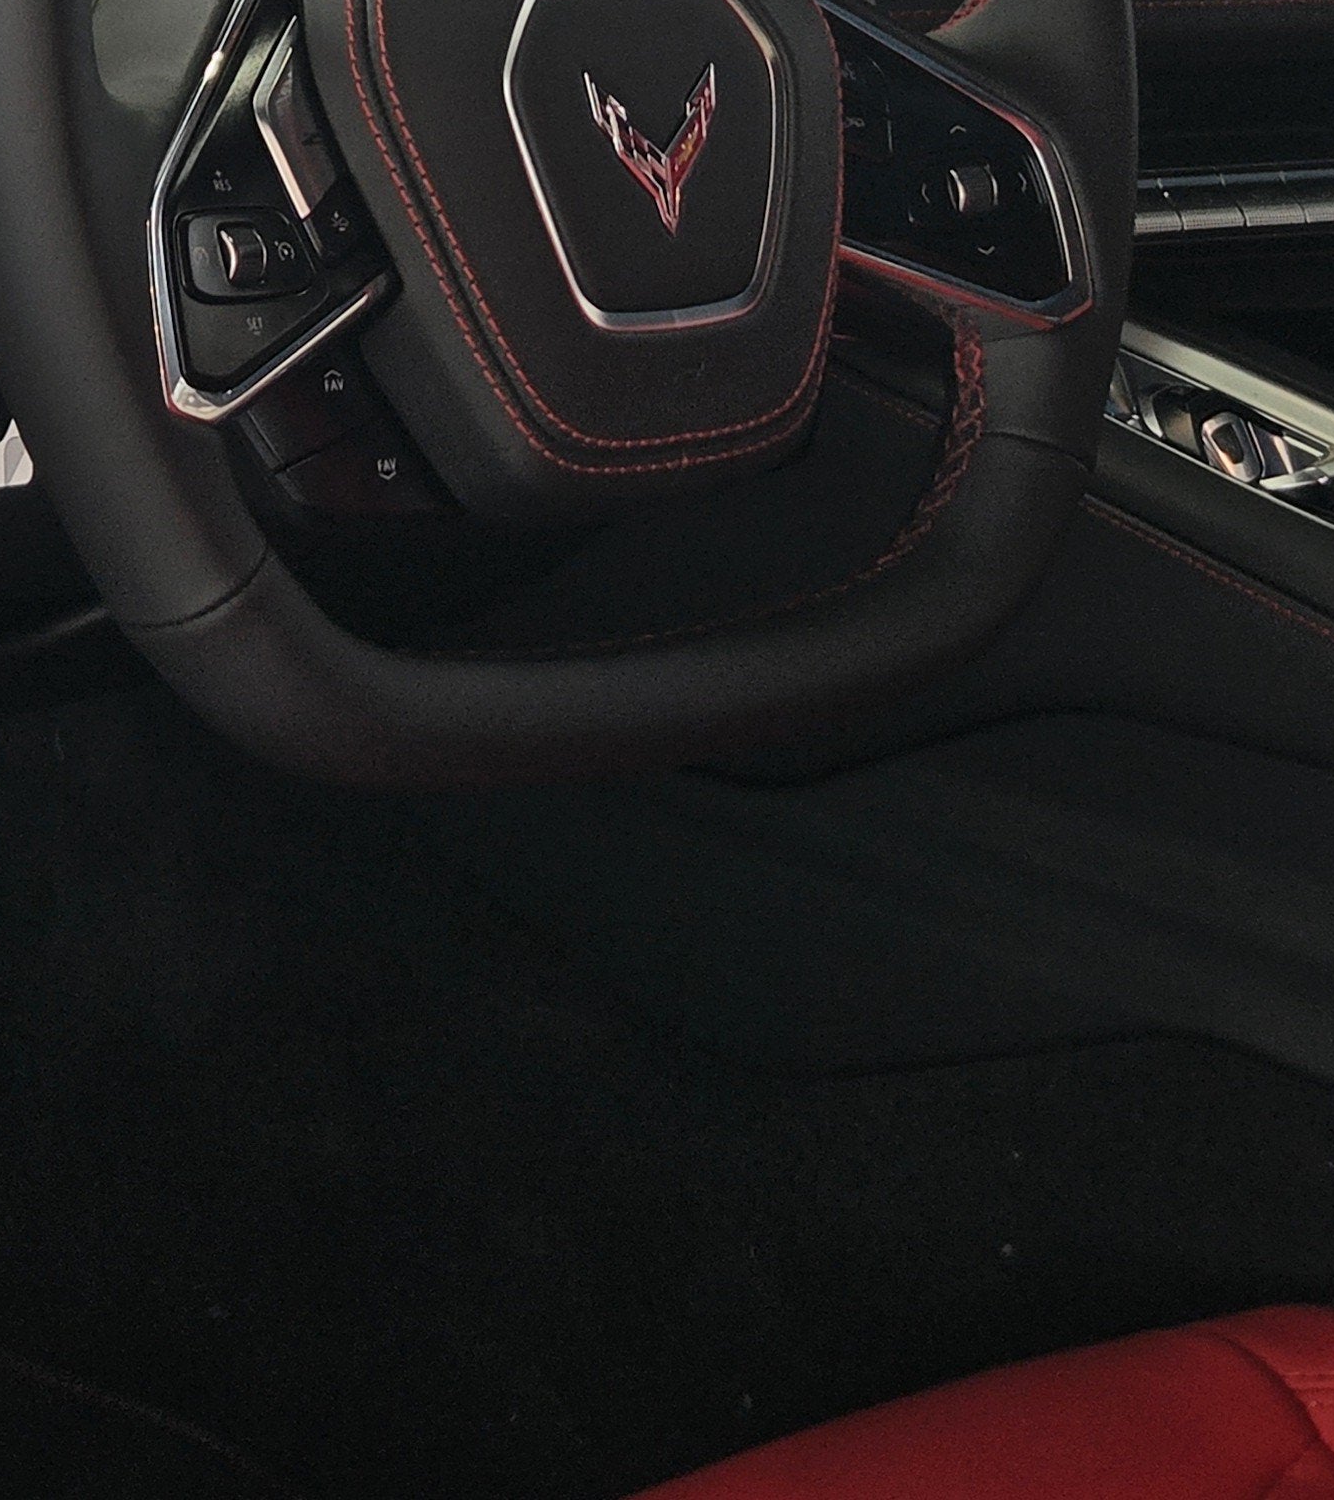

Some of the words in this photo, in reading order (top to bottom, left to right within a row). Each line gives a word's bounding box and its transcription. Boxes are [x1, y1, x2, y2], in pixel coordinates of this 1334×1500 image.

[212, 178, 233, 192] RES
[324, 378, 344, 392] FAV
[376, 457, 397, 472] FAV
